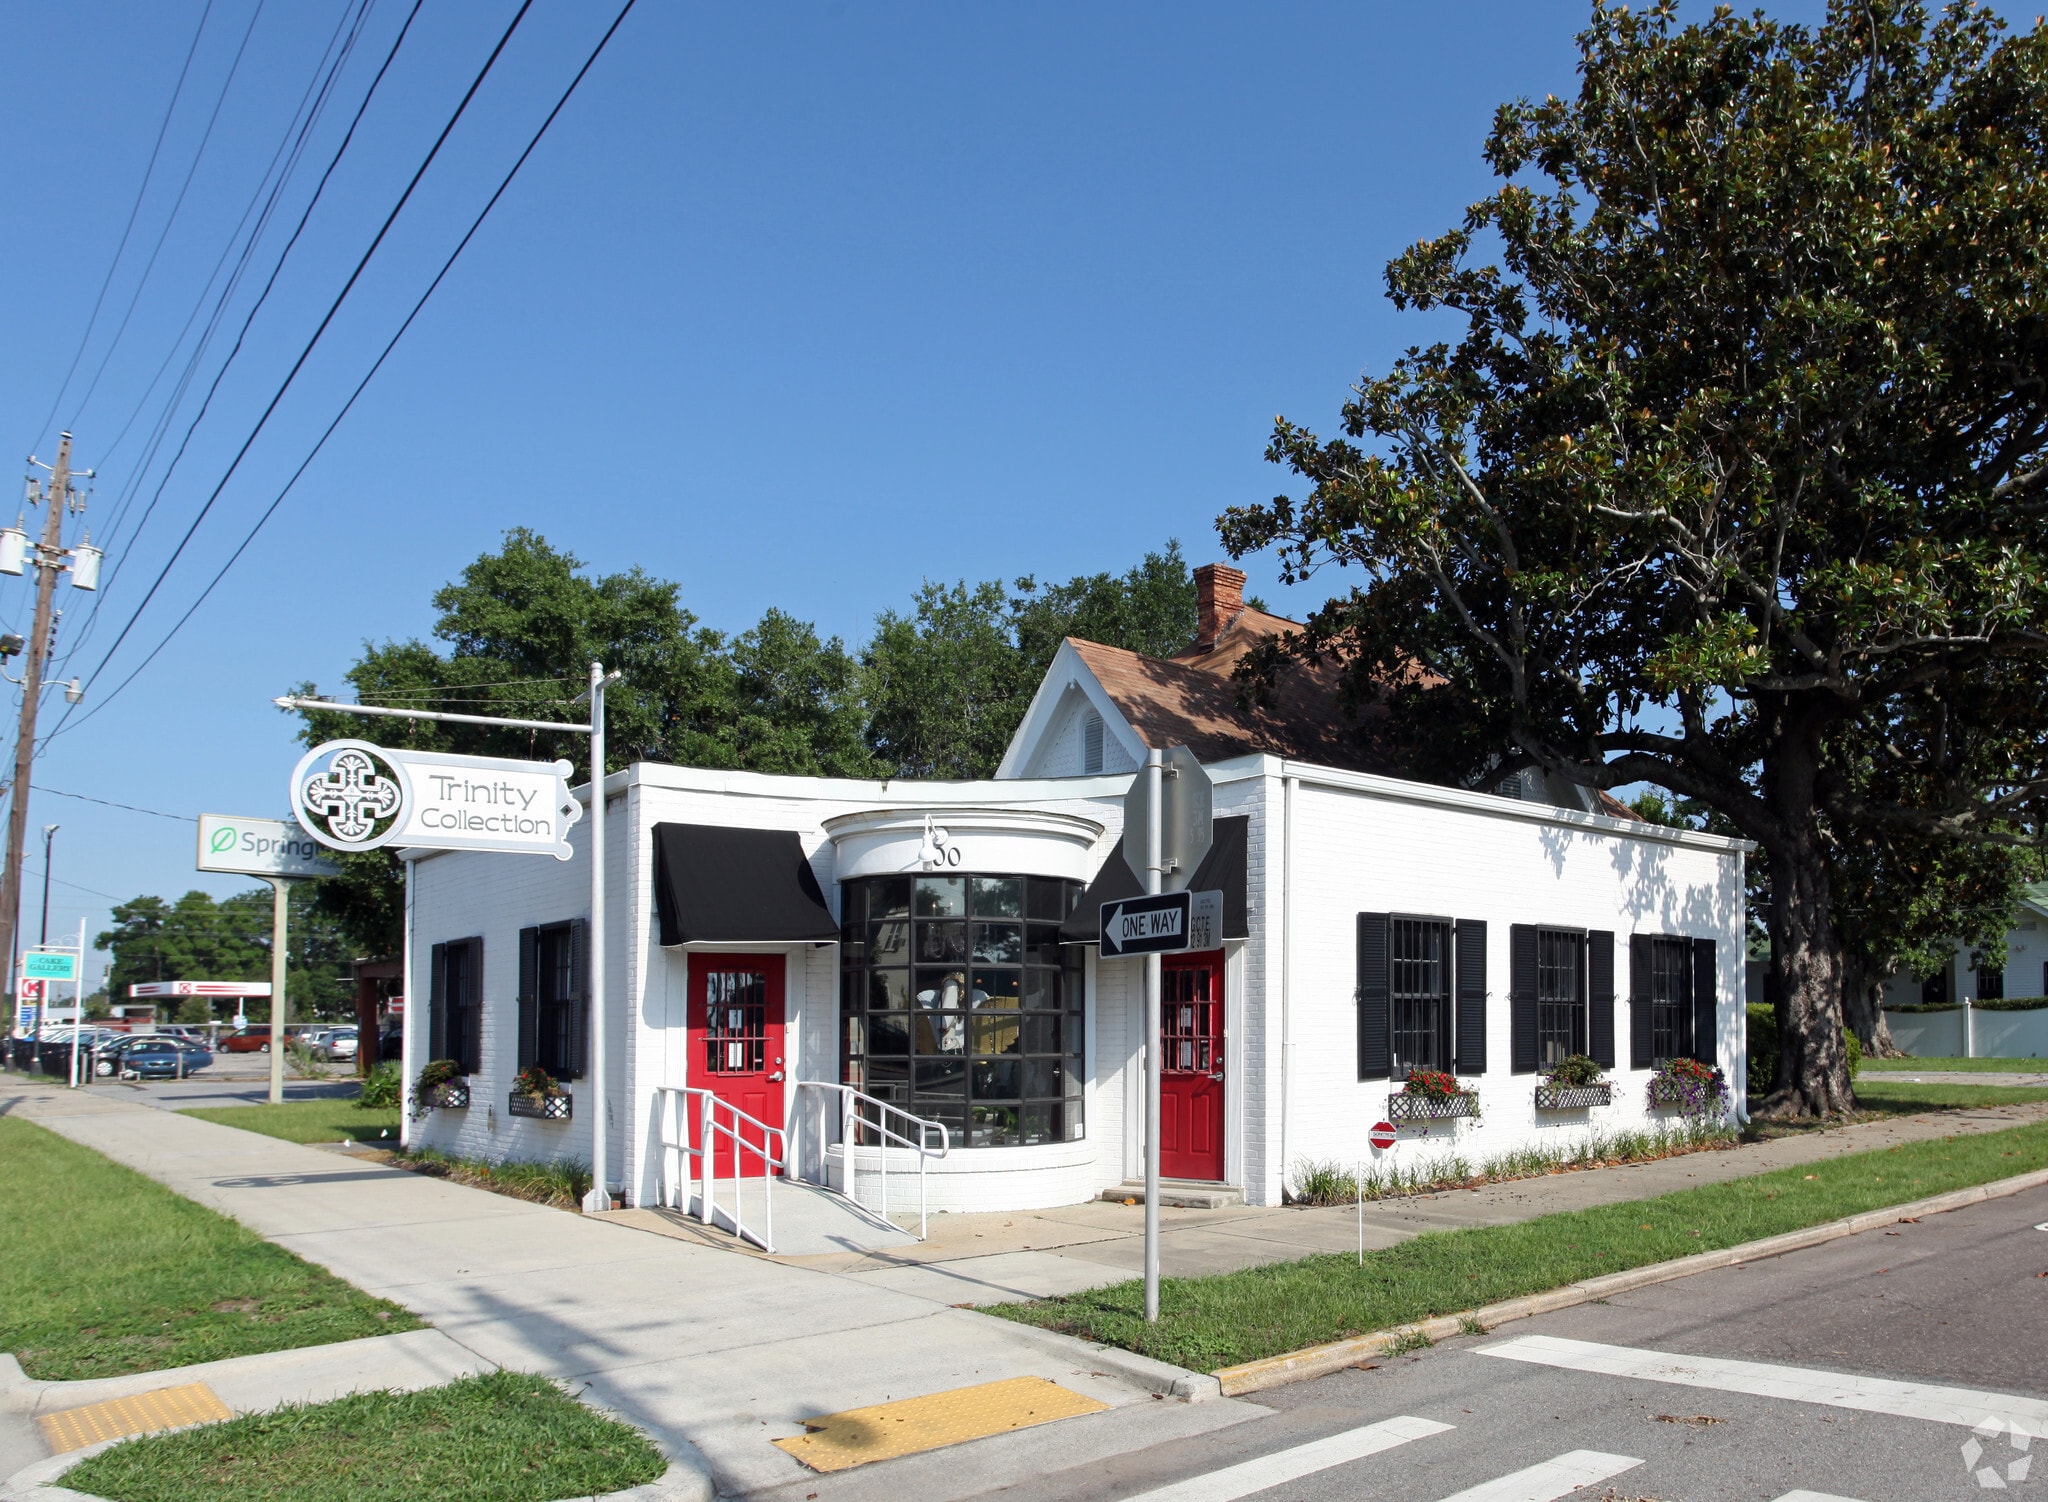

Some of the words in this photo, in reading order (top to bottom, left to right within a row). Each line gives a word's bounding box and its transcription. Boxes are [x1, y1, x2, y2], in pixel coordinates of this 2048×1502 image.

[429, 774, 538, 811] Trinity
[420, 807, 551, 836] Collection
[1122, 915, 1146, 938] ONE
[1150, 910, 1179, 935] WAY
[28, 963, 73, 972] GALLERY
[39, 957, 65, 965] CAKE
